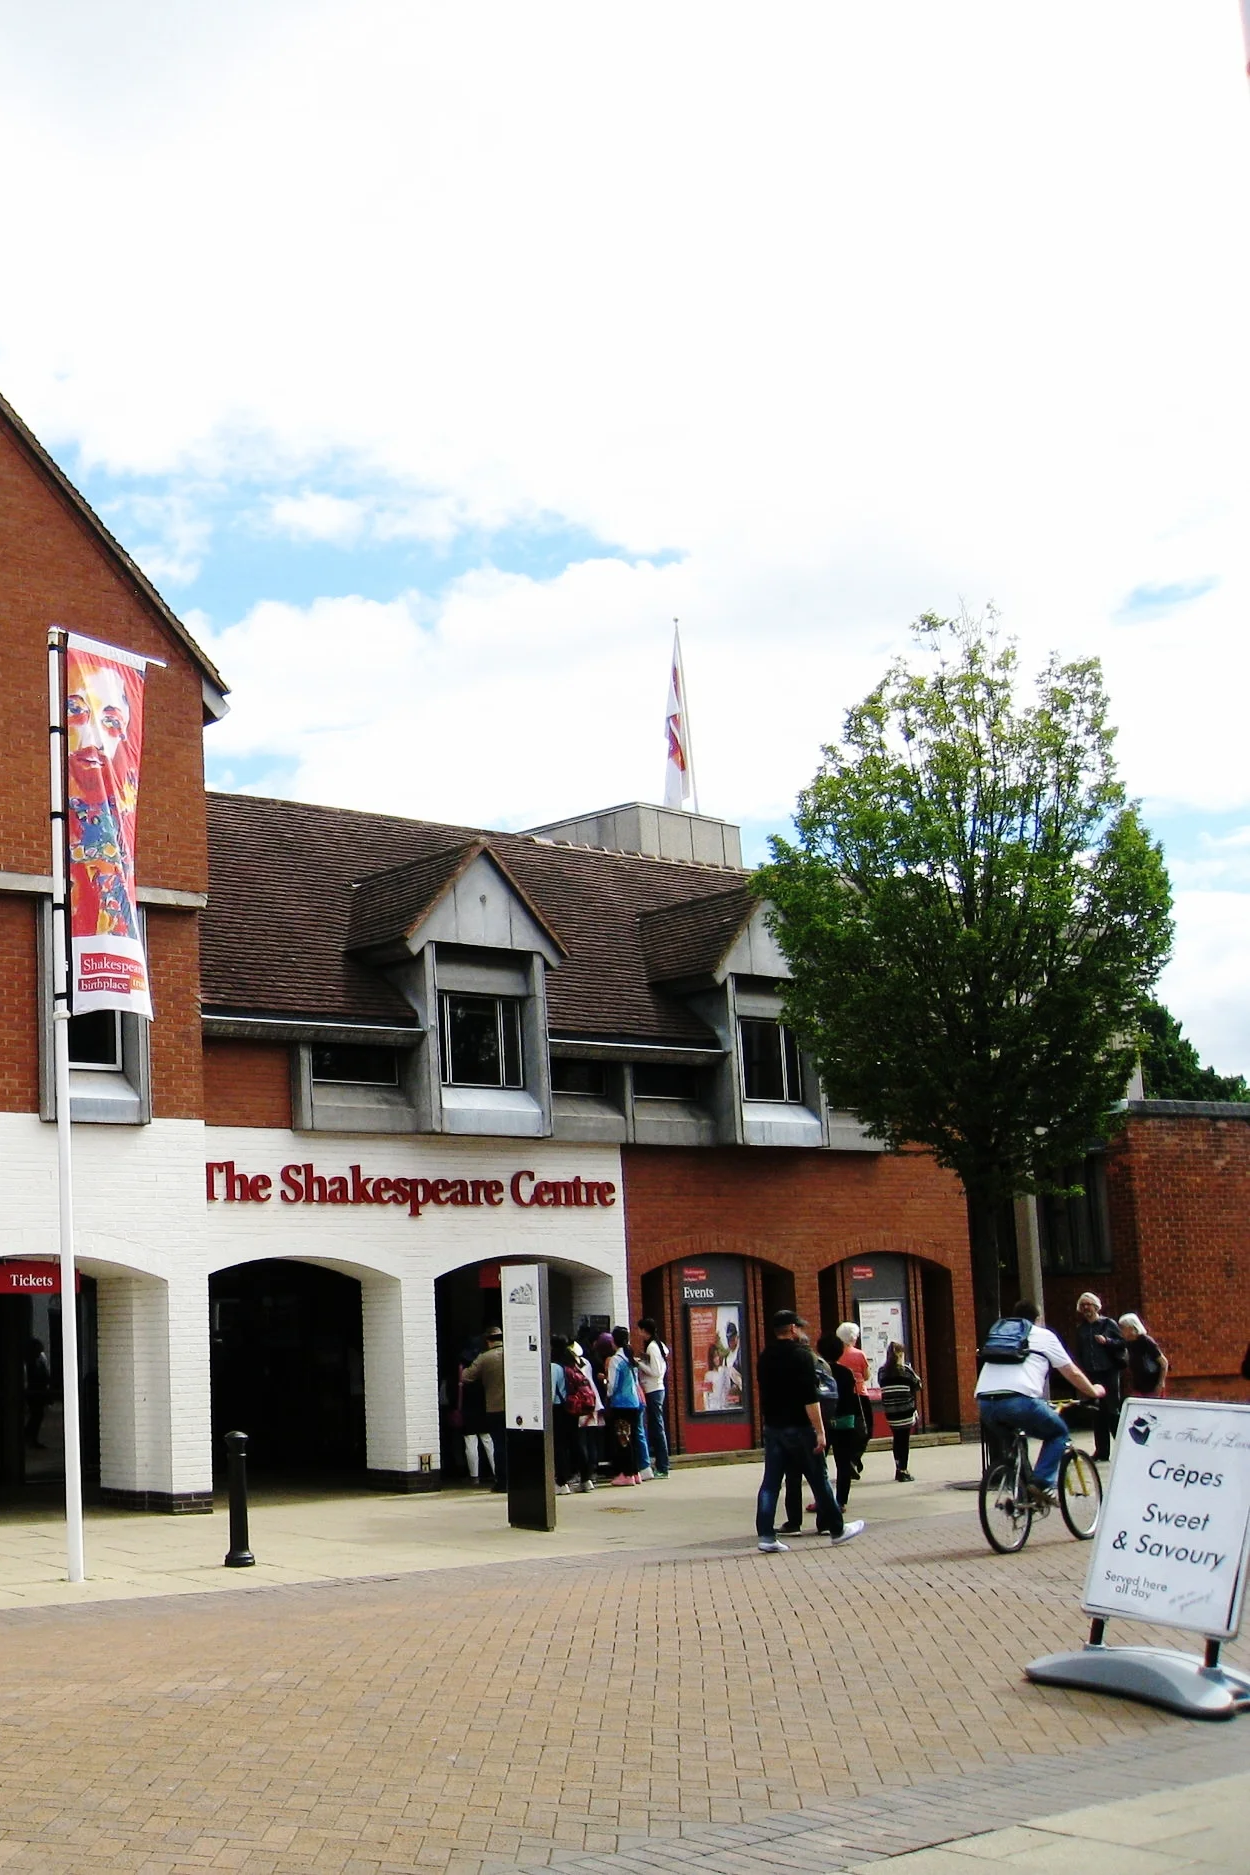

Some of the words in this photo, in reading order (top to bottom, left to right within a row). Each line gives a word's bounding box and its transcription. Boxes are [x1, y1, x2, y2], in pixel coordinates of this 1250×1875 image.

[83, 956, 144, 975] Shakespear
[81, 978, 129, 991] birthplace
[205, 1160, 272, 1203] The
[280, 1163, 504, 1217] Shakespeare
[510, 1170, 617, 1208] Centre
[10, 1274, 53, 1287] Tickets
[683, 1286, 714, 1299] Events
[1148, 1459, 1224, 1488] Crêpes
[1142, 1503, 1210, 1531] Sweet
[1112, 1530, 1128, 1551] &
[1135, 1534, 1226, 1572] Savoury
[1105, 1570, 1141, 1586] Served
[1142, 1577, 1168, 1592] here
[1115, 1584, 1129, 1595] all
[1131, 1586, 1151, 1601] day
